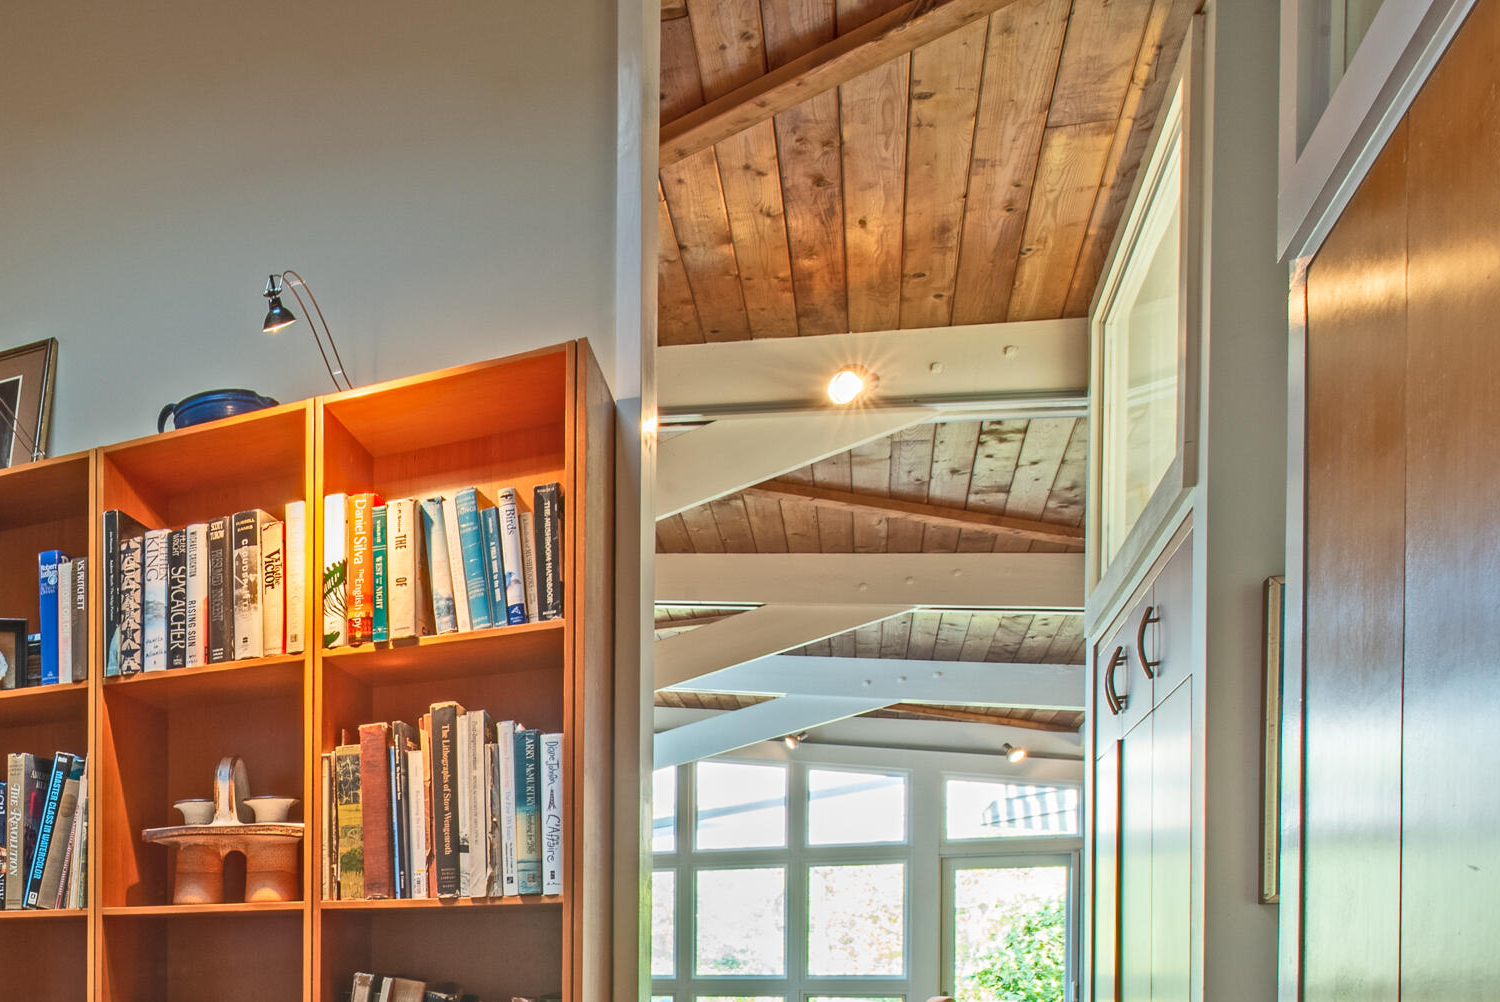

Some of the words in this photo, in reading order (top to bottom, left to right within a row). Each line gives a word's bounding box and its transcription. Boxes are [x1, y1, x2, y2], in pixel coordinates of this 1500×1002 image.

[355, 499, 367, 535] Daniel
[505, 509, 515, 535] Birds
[172, 533, 180, 556] WRIGHT
[189, 531, 197, 553] MICHAEL
[353, 537, 367, 564] Silva
[395, 534, 406, 550] THE
[544, 517, 552, 562] MUSHROOM
[146, 536, 159, 582] KING
[159, 533, 168, 581] STEPHEN
[189, 553, 197, 577] CRICHTON
[212, 549, 223, 586] PRESUMED
[275, 563, 282, 573] To
[264, 548, 280, 594] Victor
[396, 577, 407, 587] OF
[212, 589, 224, 622] INNOCENT
[353, 578, 364, 610] English
[170, 566, 186, 650] SPYCATCHER
[188, 600, 196, 627] RISING
[352, 612, 364, 628] Spy
[188, 630, 196, 647] SUN
[441, 724, 450, 739] The
[526, 733, 534, 760] LARRY
[547, 741, 559, 761] Diane
[441, 740, 450, 783] Lithographs
[10, 784, 20, 806] THE
[50, 771, 63, 800] MASTER
[442, 784, 450, 793] of
[526, 763, 536, 807] McMURTRY
[45, 801, 57, 824] CLASS
[443, 794, 451, 811] Stow
[44, 824, 52, 833] IN
[441, 812, 452, 855] Wengenroth
[9, 808, 21, 877] REVOLUTION
[33, 834, 51, 879] WATERCOLOR
